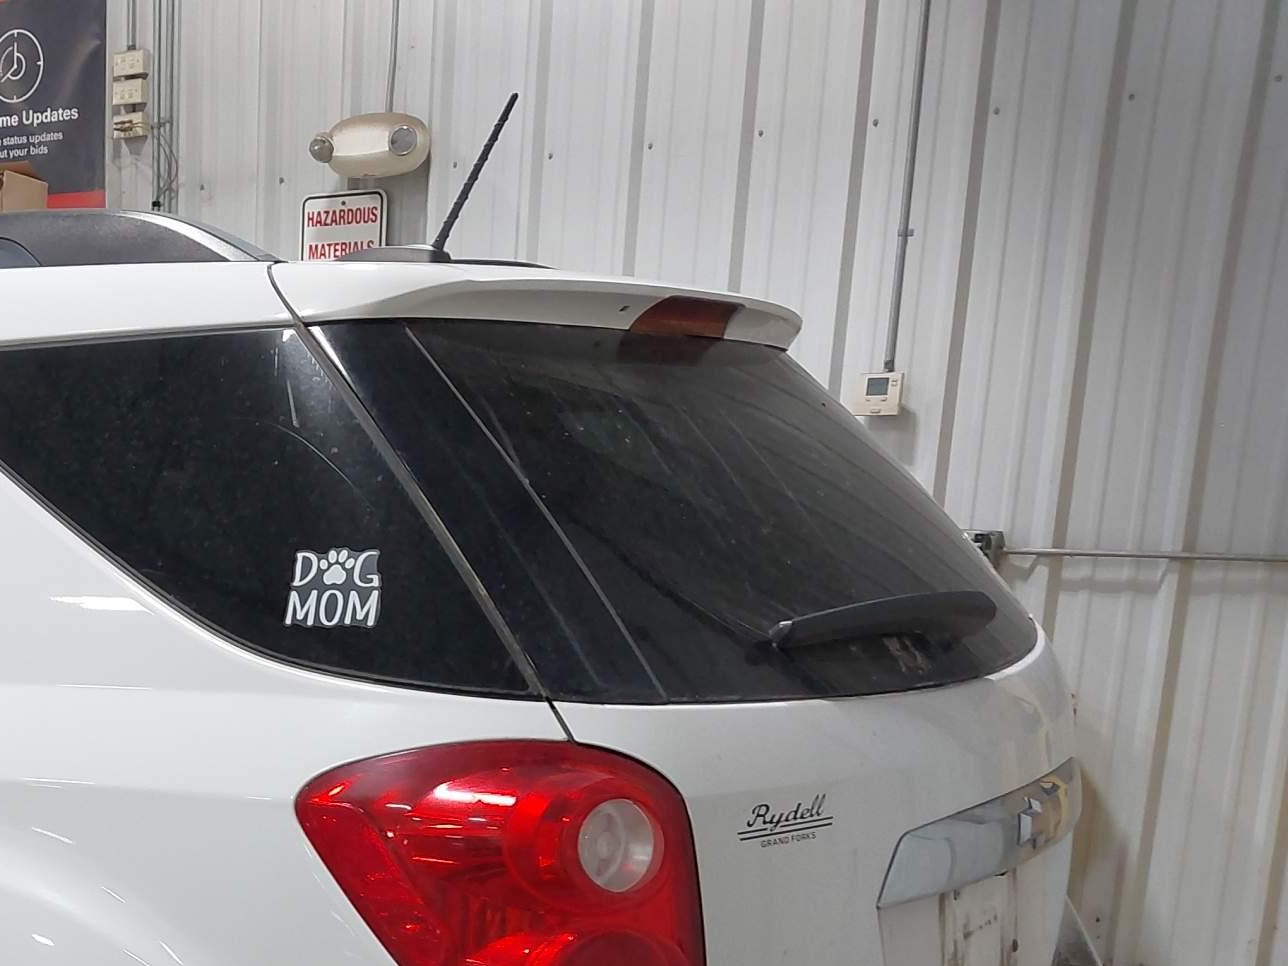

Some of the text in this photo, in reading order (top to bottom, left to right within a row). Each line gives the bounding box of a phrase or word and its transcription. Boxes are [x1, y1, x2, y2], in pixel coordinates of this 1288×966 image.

[22, 107, 79, 128] Updates
[2, 134, 28, 146] status
[28, 131, 64, 144] updates
[9, 147, 29, 159] your
[30, 144, 49, 155] bids
[306, 206, 379, 228] HAZARDOUS
[285, 589, 380, 626] MOM
[746, 793, 827, 832] Rydell
[760, 831, 817, 848] GRAND FORKS
